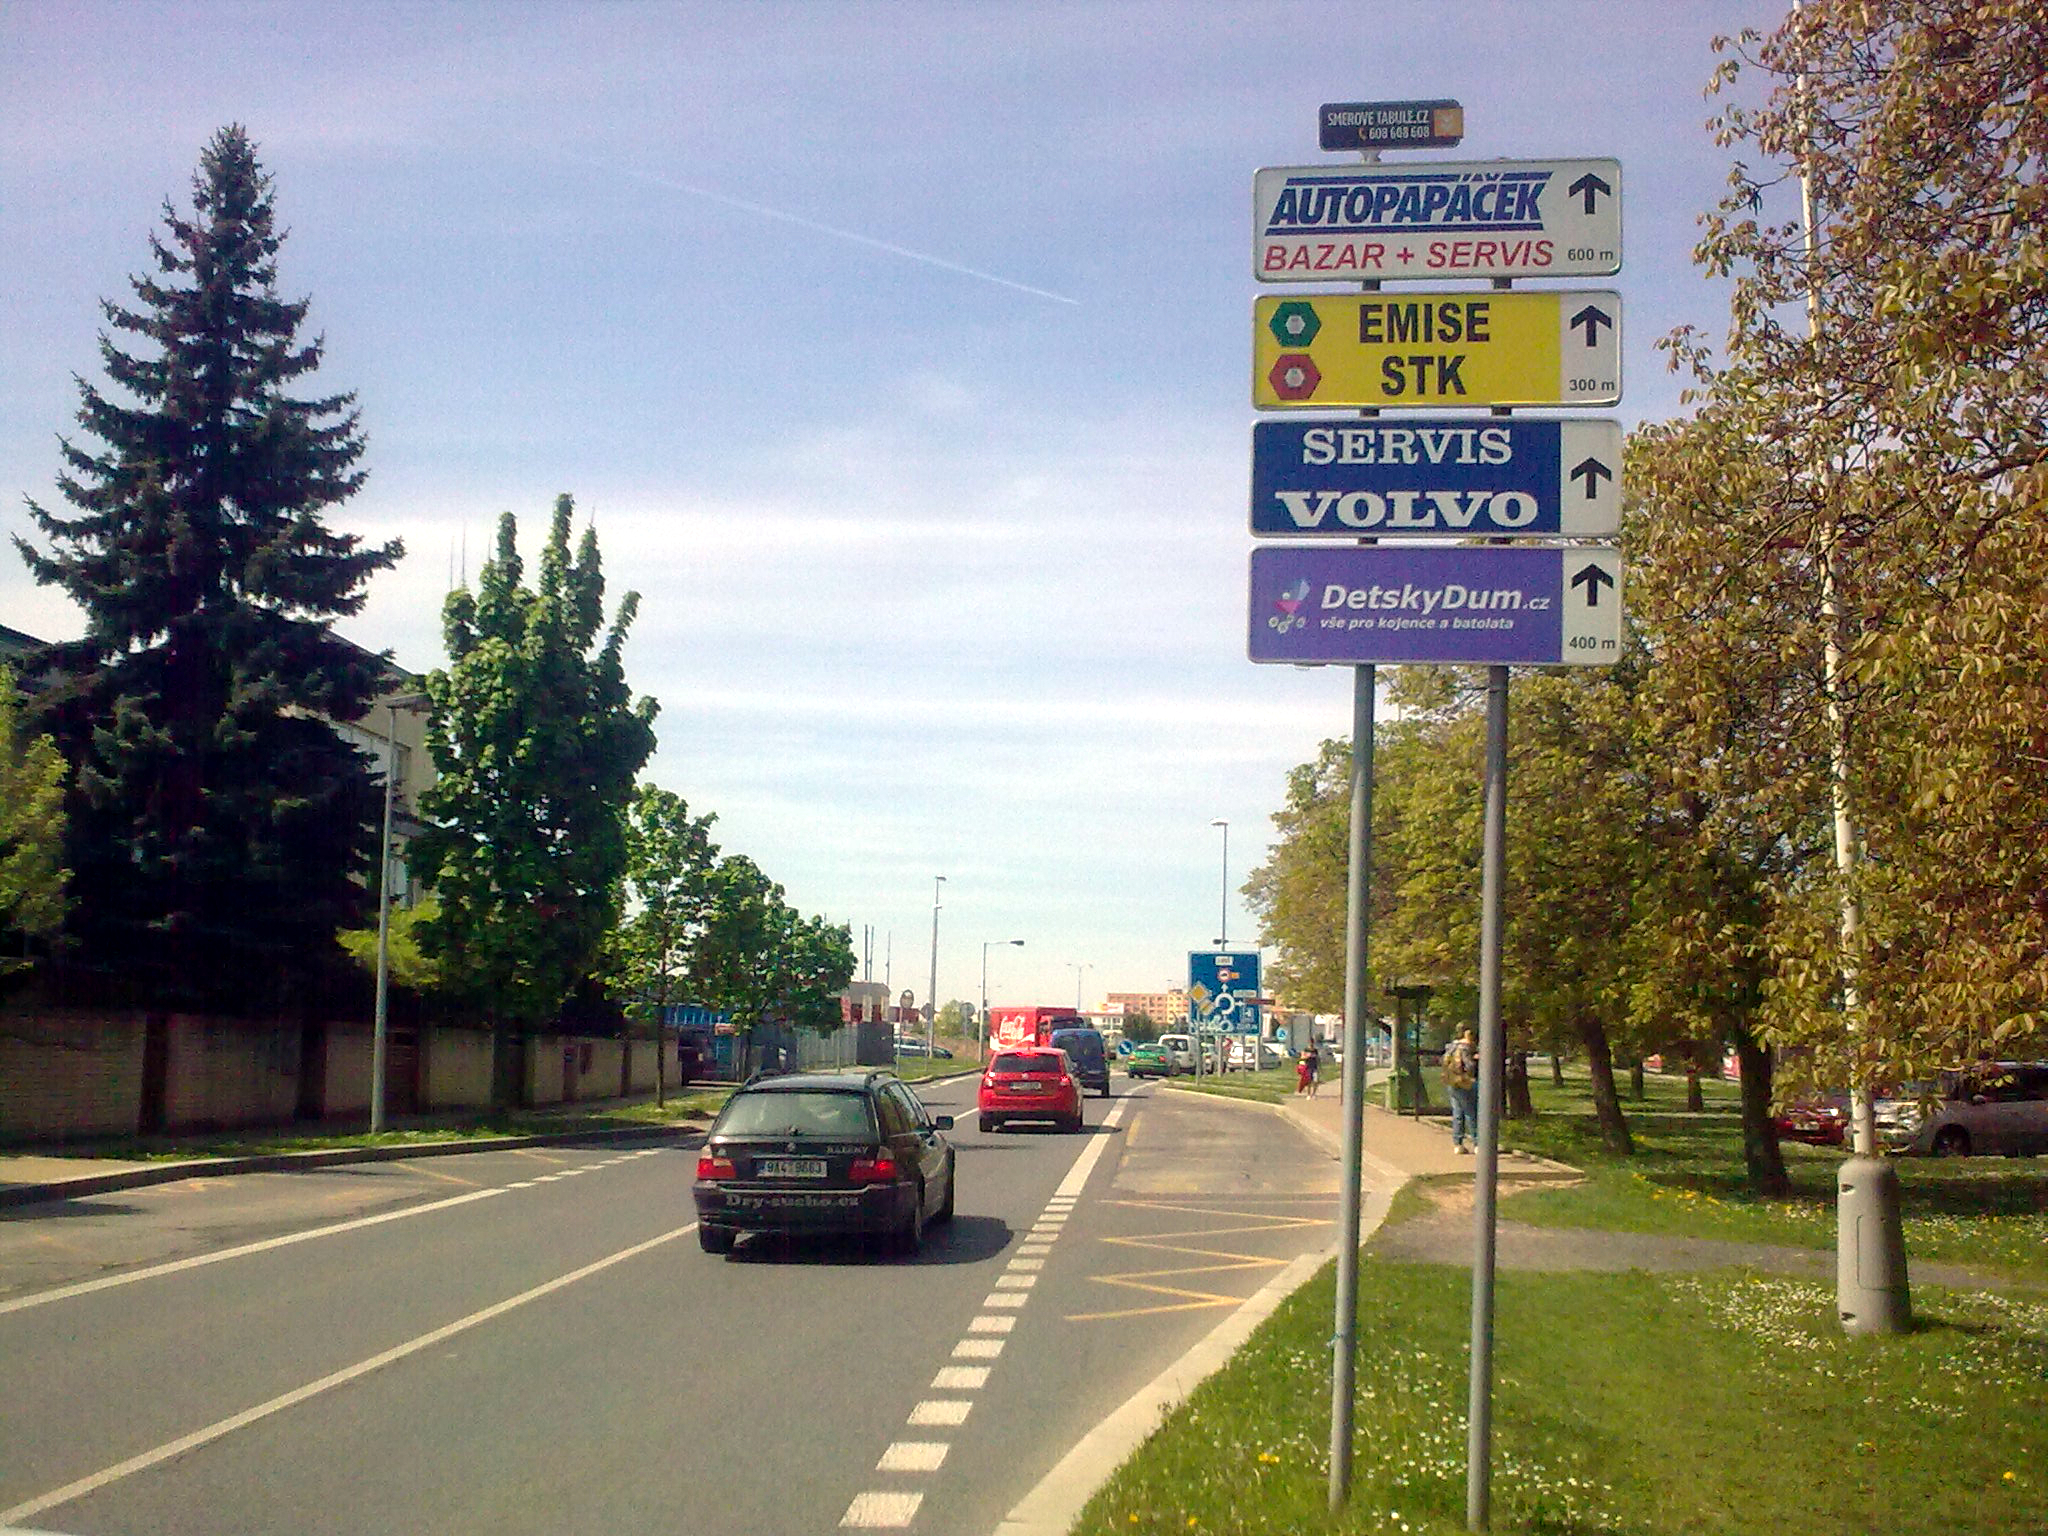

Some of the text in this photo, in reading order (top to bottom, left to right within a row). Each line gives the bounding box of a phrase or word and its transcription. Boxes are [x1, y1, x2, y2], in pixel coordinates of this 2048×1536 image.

[1264, 242, 1386, 271] BAZAR
[1426, 240, 1554, 269] SERVIS
[1567, 248, 1614, 262] 600 m
[1359, 303, 1490, 343] EMISE
[1380, 355, 1468, 396] STK
[1569, 378, 1615, 391] 300 m
[1302, 428, 1513, 465] SERVIS
[1275, 491, 1539, 528] VOLVO
[1320, 585, 1551, 616] DetskyDum.cz
[1320, 617, 1514, 631] vše pro kojence a batolata
[1568, 637, 1616, 650] 400 m
